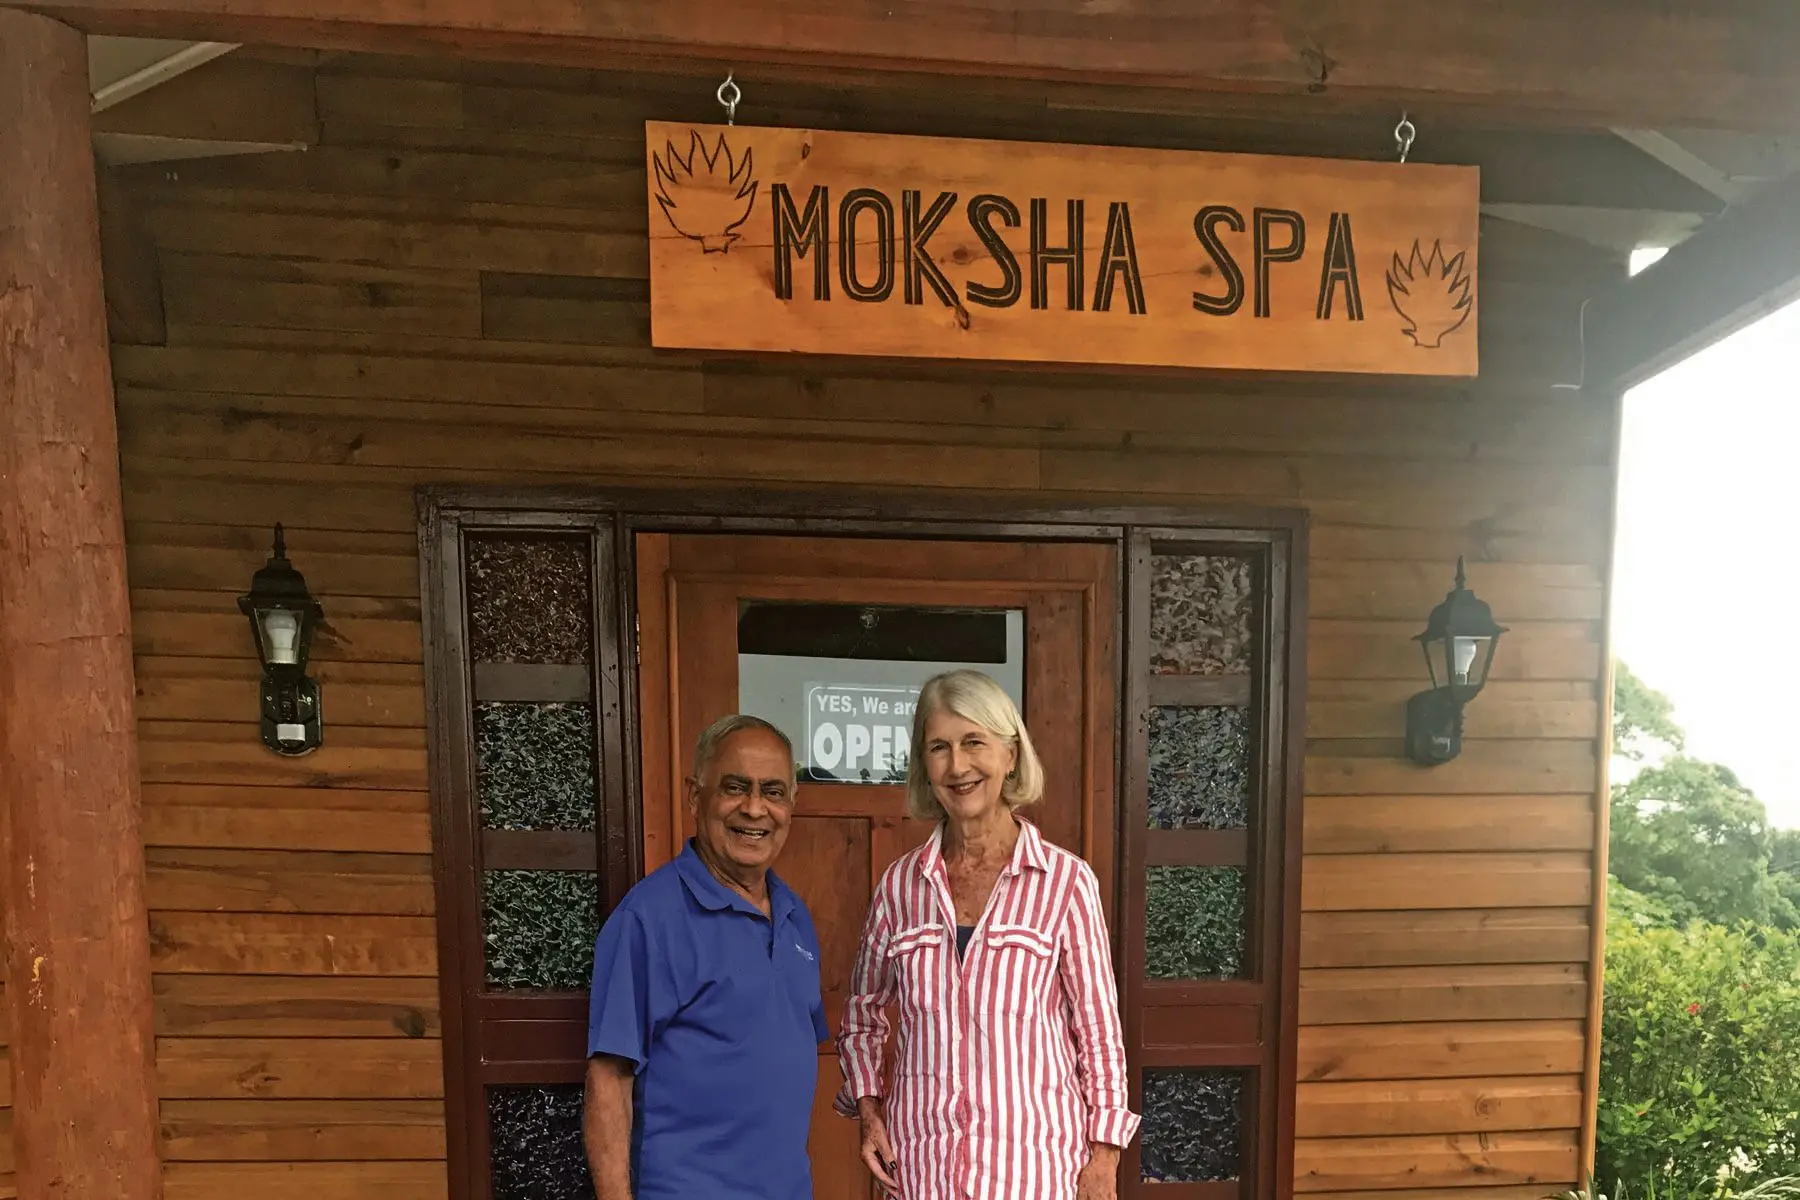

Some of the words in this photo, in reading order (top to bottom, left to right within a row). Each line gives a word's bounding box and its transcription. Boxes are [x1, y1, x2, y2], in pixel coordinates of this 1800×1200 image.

[771, 183, 1147, 314] MOKSHA
[1192, 205, 1364, 320] SPA
[816, 694, 857, 717] YES,
[863, 696, 889, 714] We
